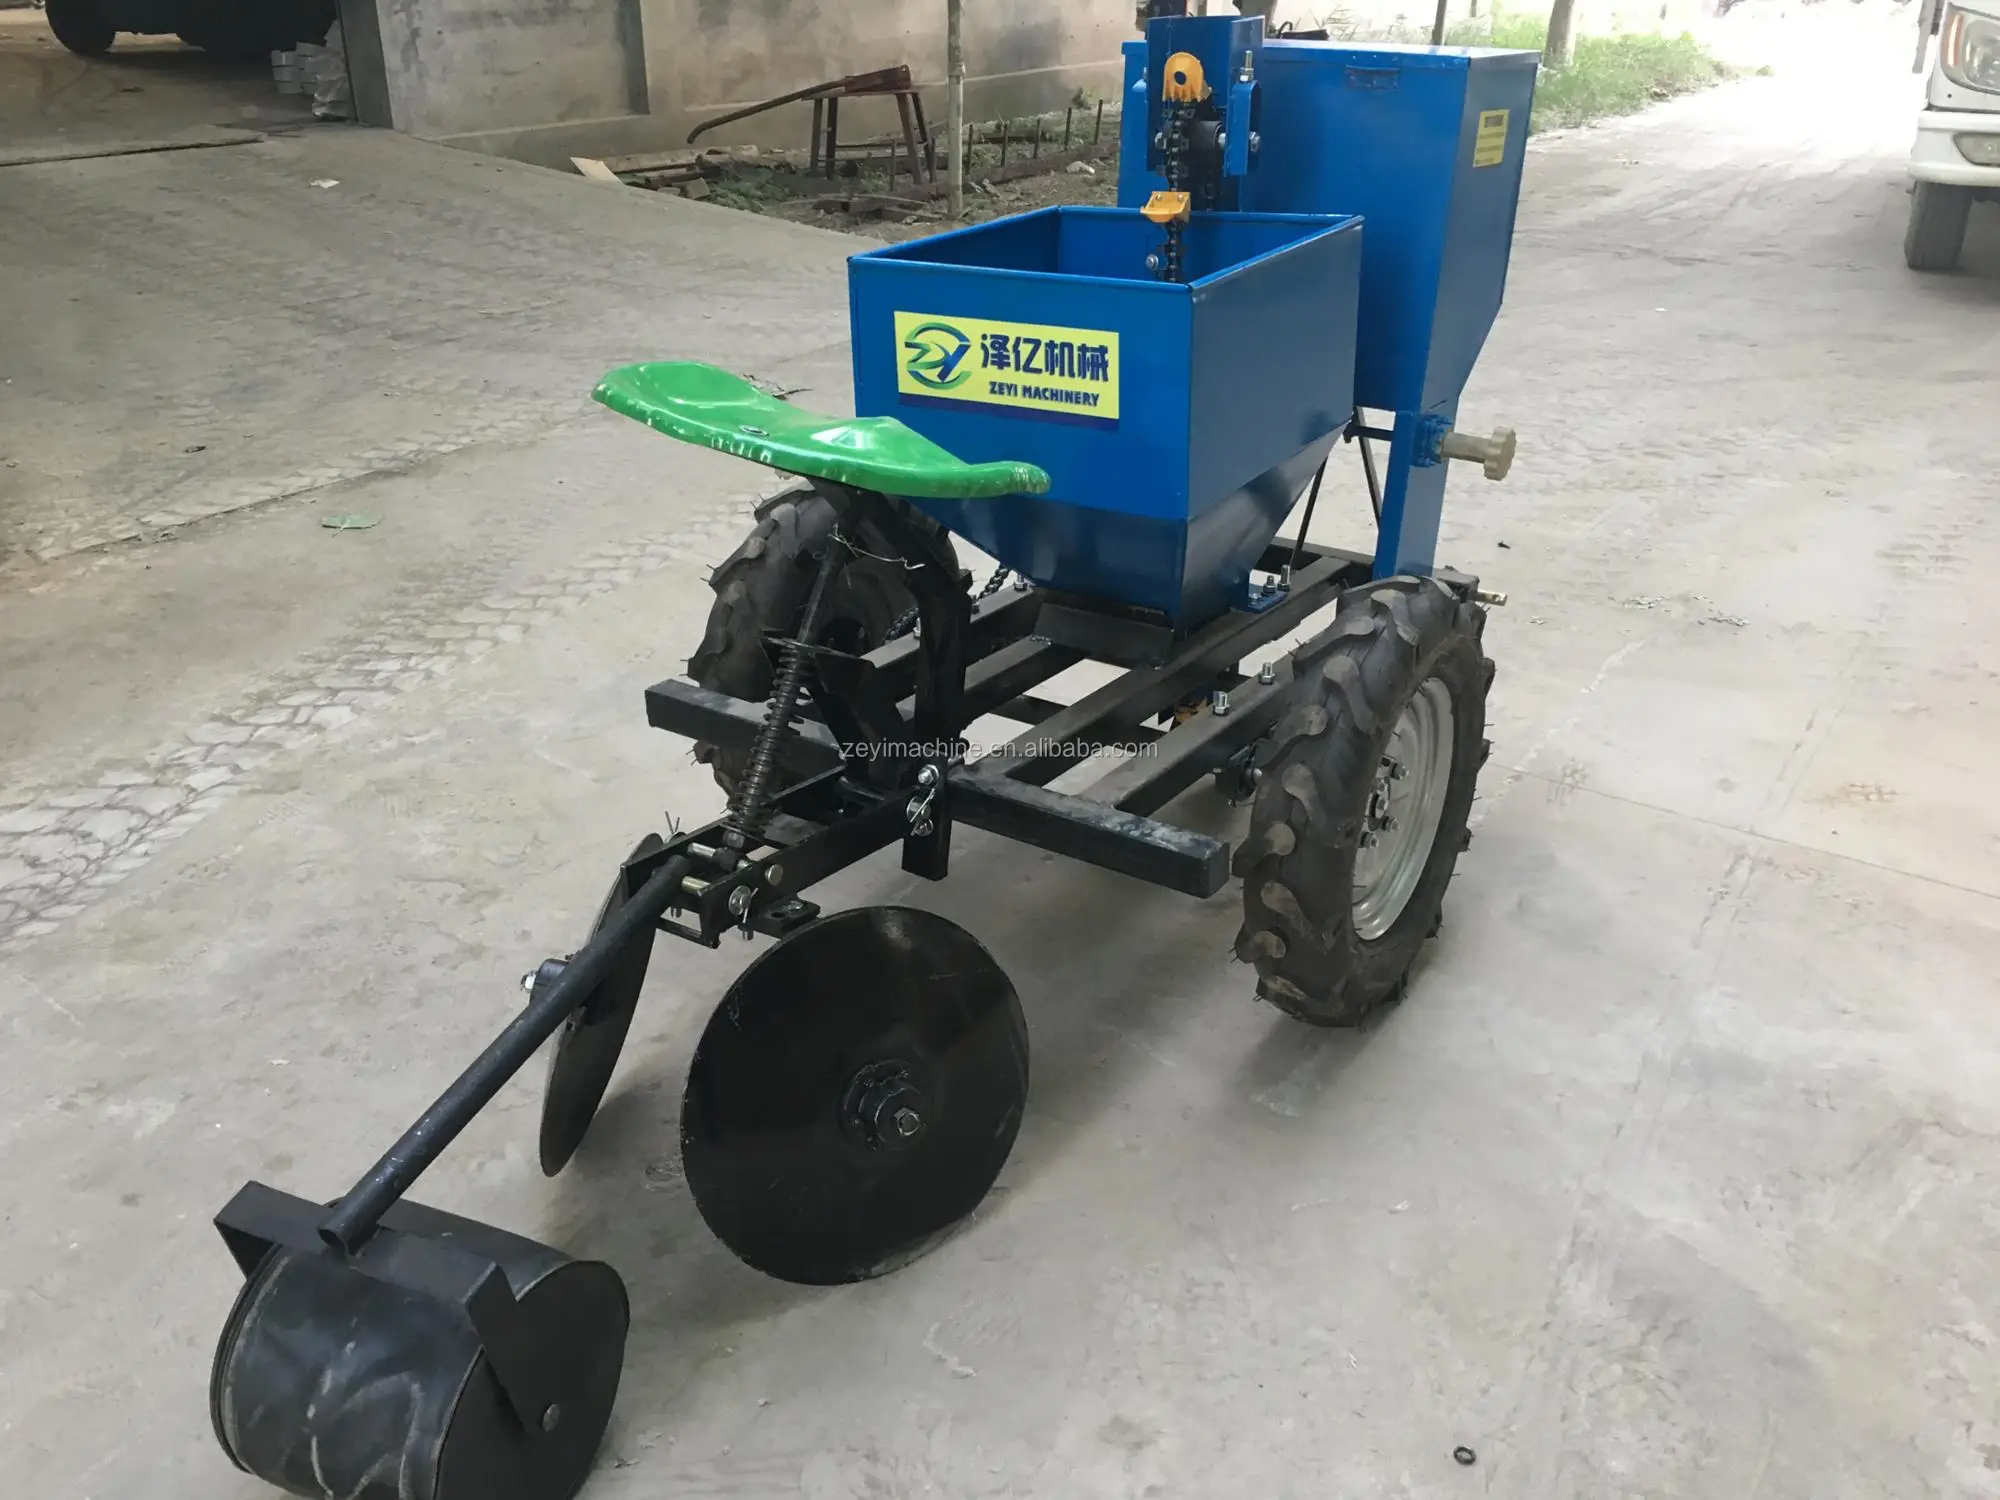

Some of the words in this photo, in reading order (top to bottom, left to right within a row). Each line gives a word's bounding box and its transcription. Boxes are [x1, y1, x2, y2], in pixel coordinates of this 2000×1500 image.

[981, 333, 1109, 382] 泽亿机械
[989, 381, 1018, 397] ZEYI
[1022, 385, 1100, 407] MACHINERY
